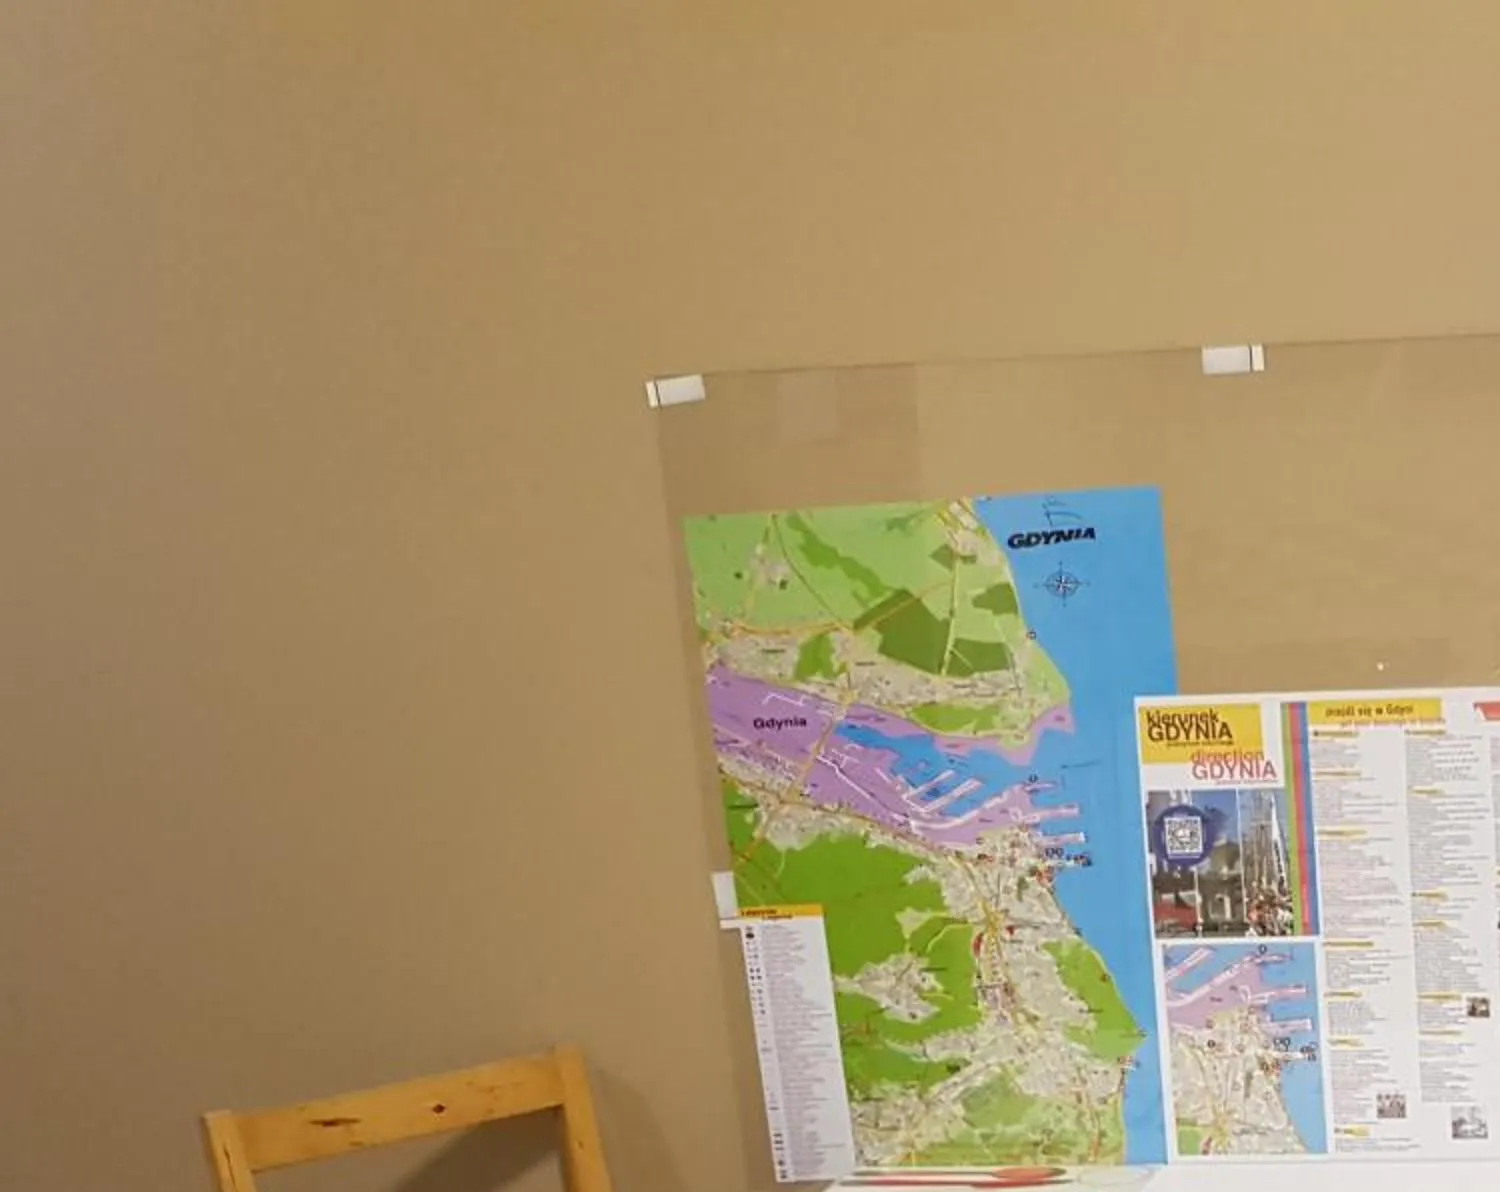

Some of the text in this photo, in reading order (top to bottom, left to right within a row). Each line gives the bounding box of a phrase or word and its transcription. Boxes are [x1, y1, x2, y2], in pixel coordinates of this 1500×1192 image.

[1007, 526, 1097, 550] GDYNIA
[753, 716, 808, 731] Gdynia
[1146, 707, 1221, 726] kierunek
[1146, 721, 1234, 743] GDYNIA
[1190, 748, 1266, 765] direction
[1191, 760, 1278, 781] GDYNIA
